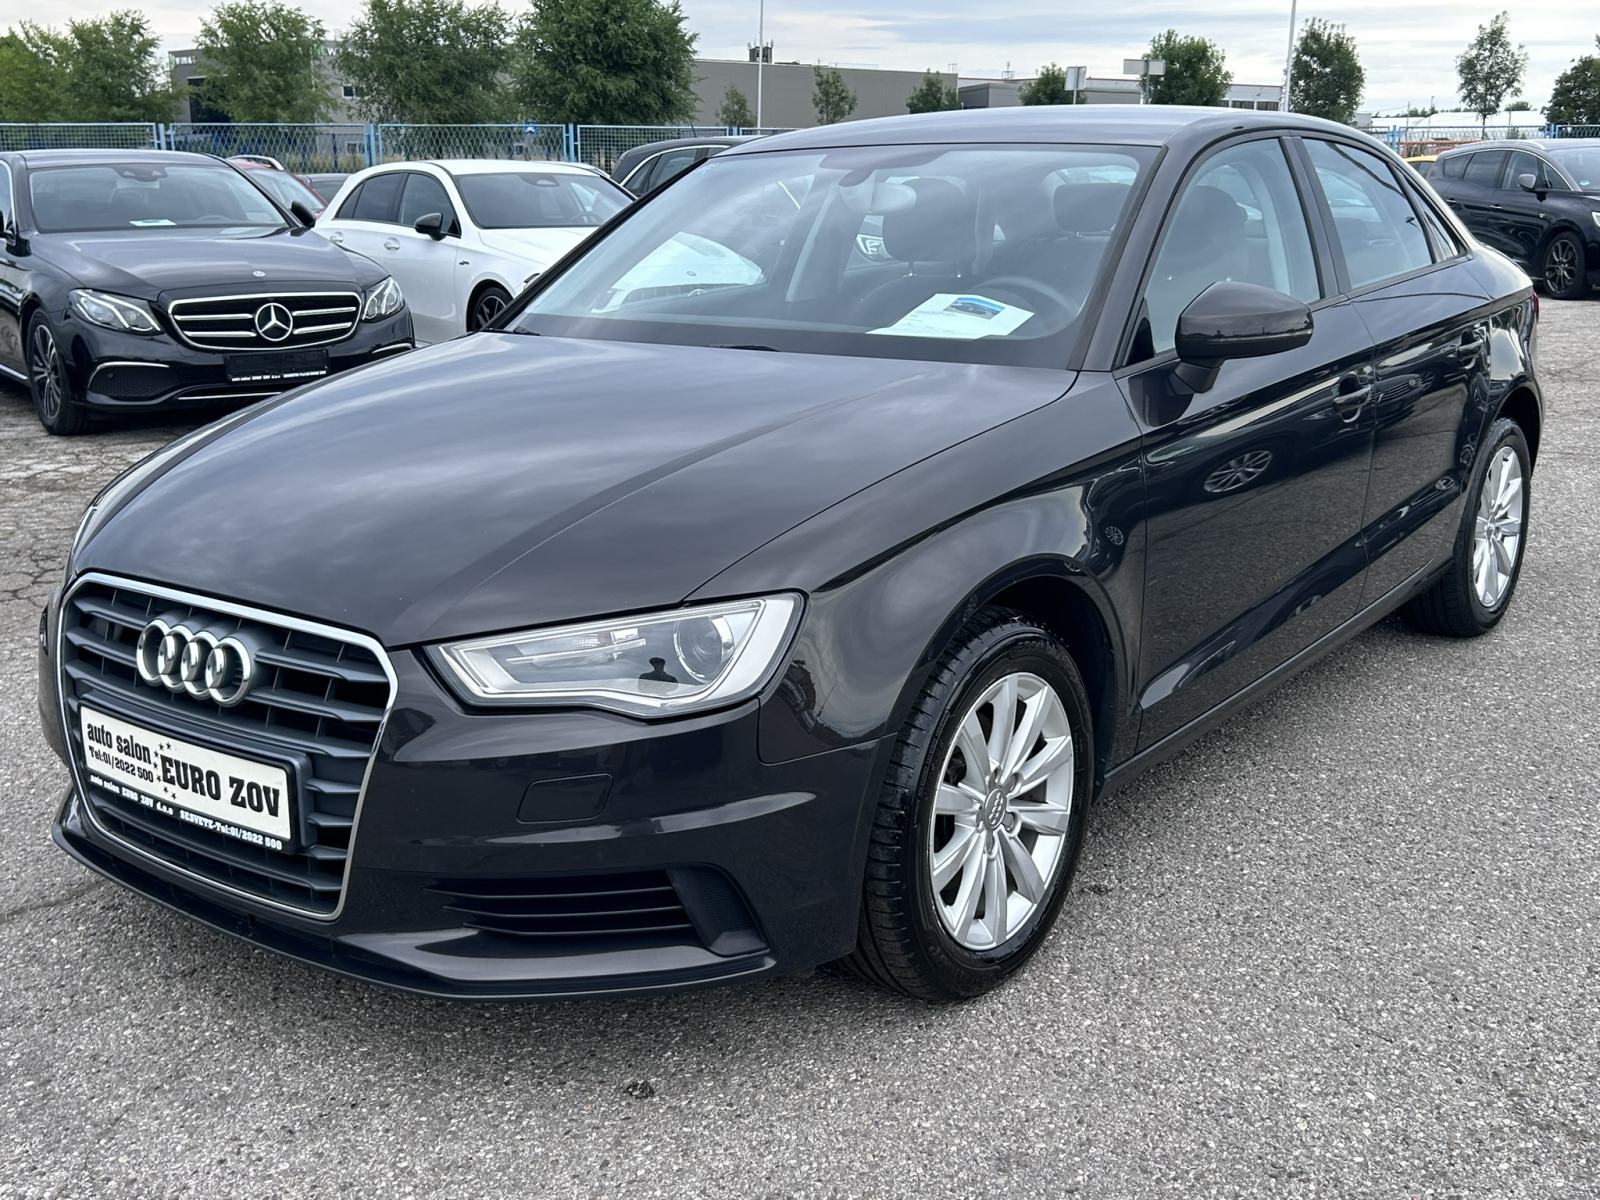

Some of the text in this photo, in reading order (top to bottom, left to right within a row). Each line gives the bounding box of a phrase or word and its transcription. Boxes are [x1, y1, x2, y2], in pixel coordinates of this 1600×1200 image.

[87, 723, 152, 765] auto salon
[137, 766, 154, 783] 500
[160, 754, 280, 818] EURO ZOV
[264, 836, 283, 851] 500
